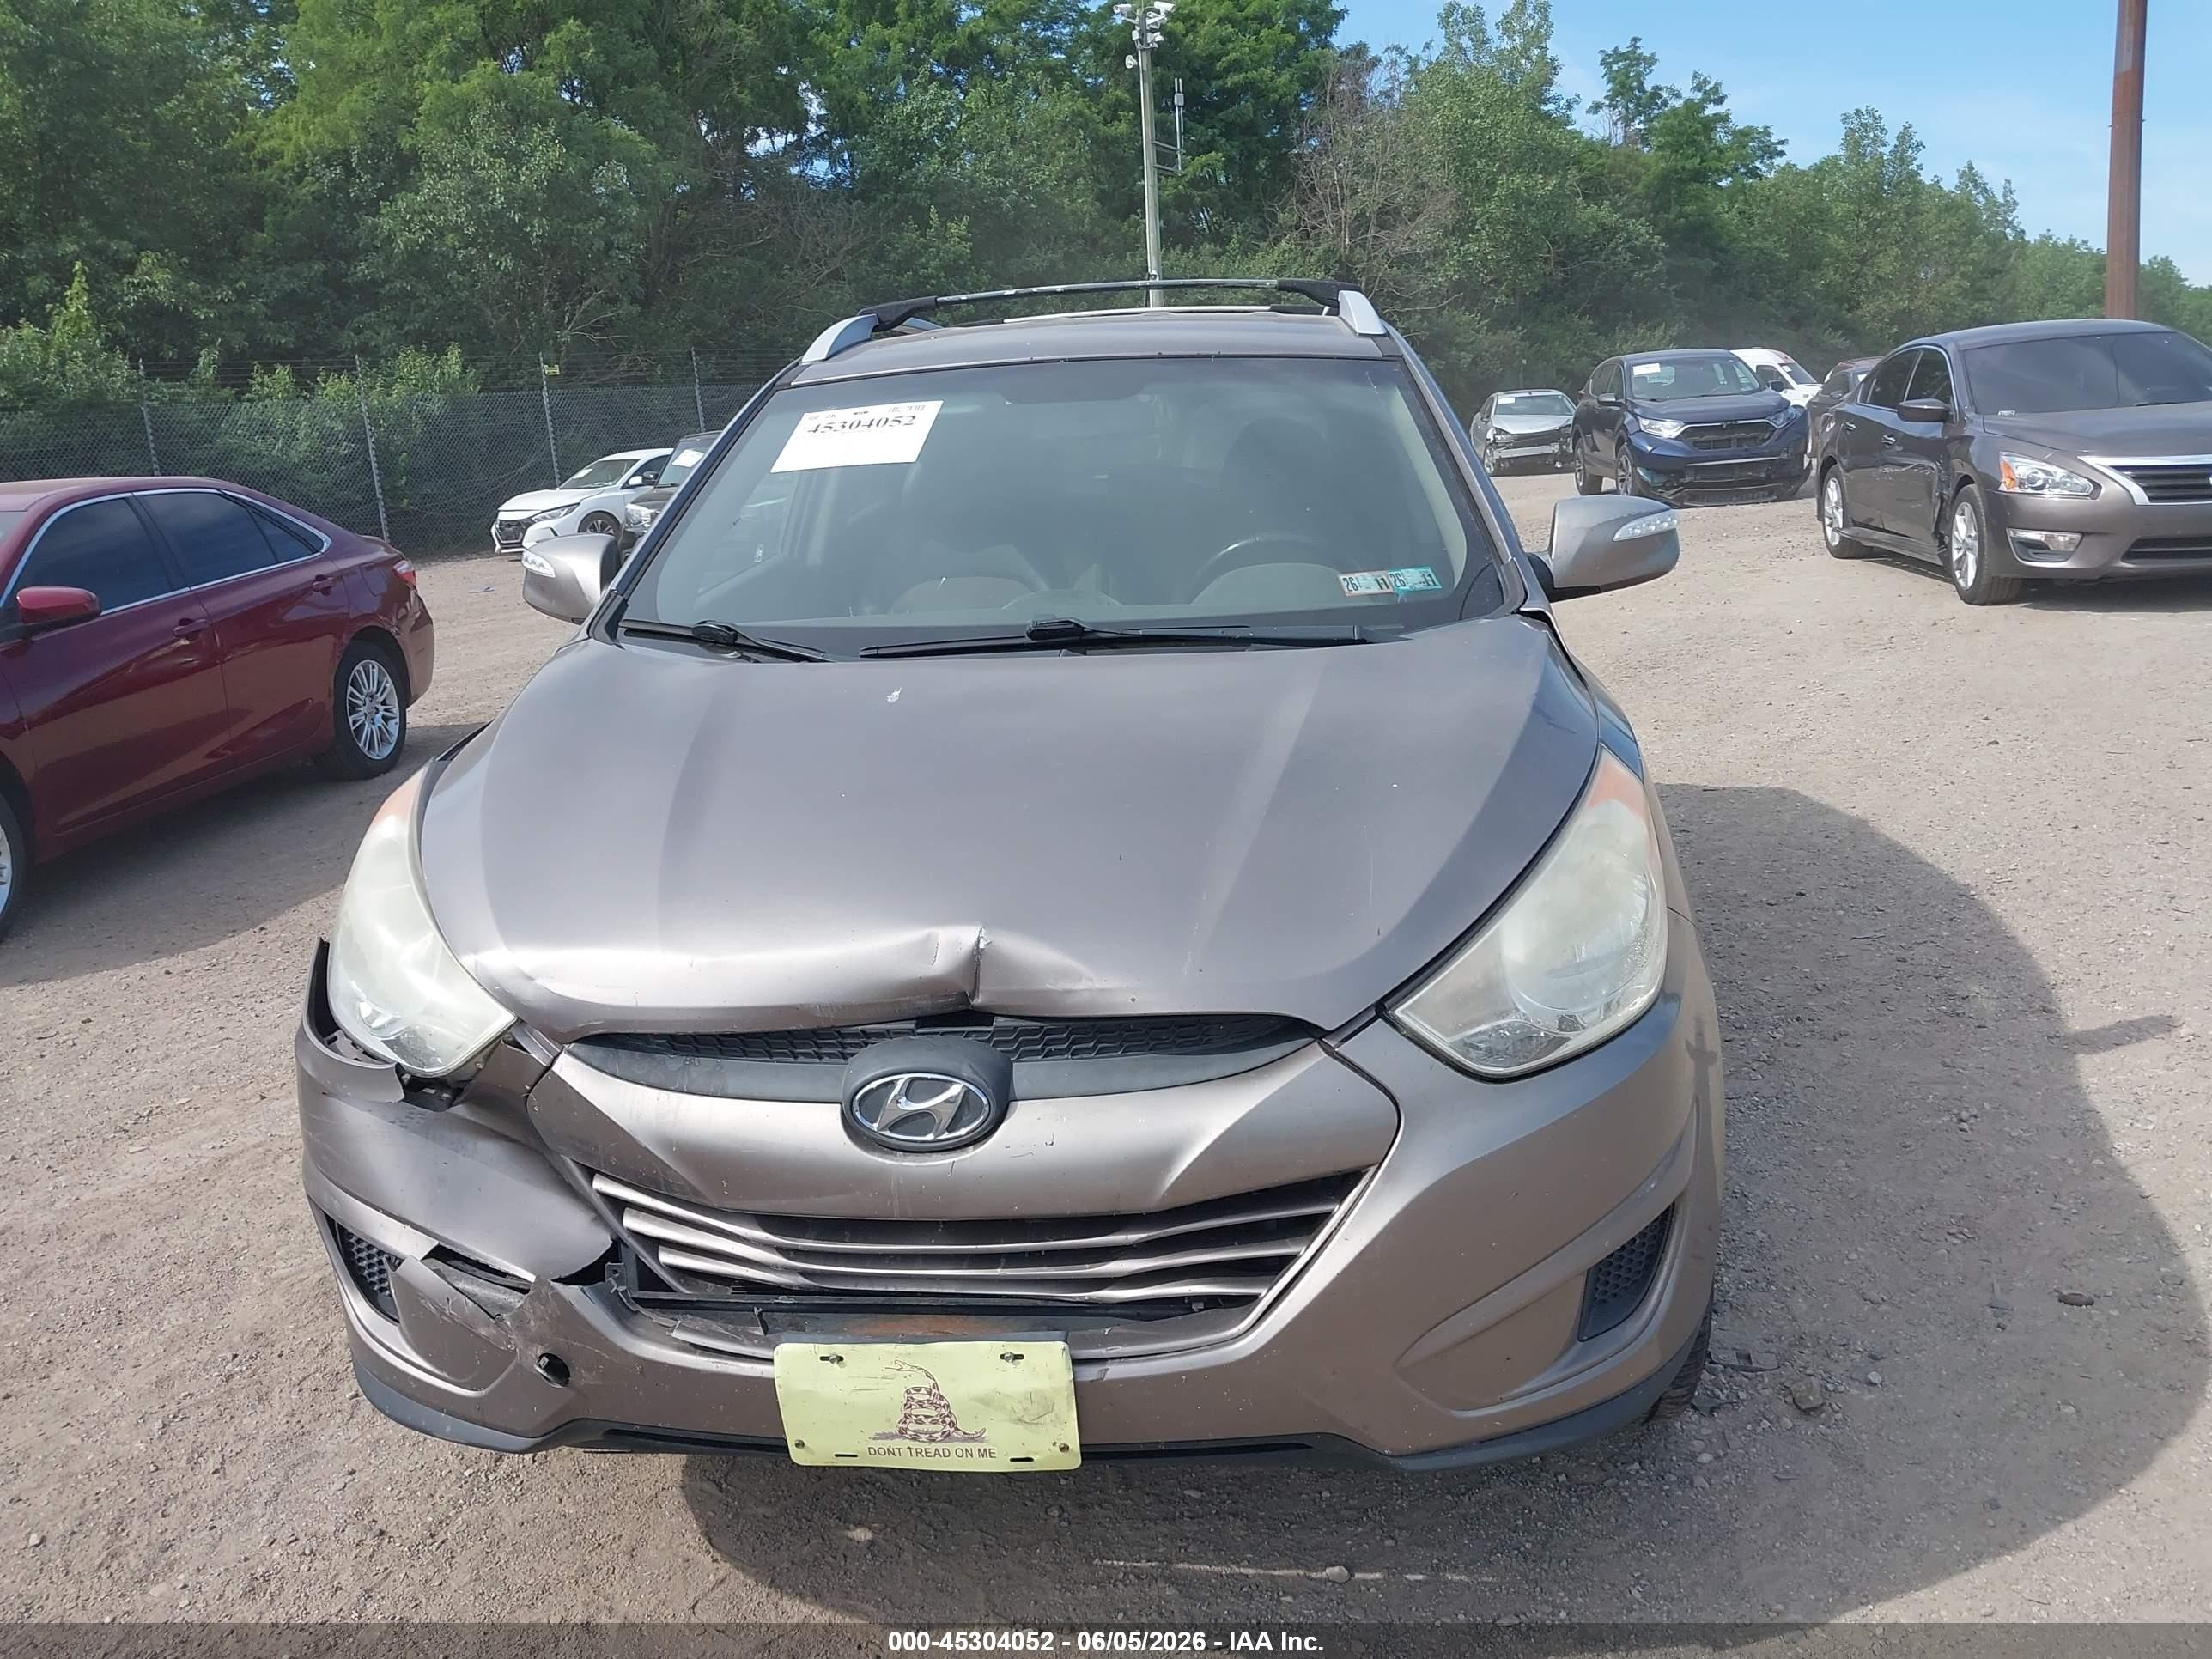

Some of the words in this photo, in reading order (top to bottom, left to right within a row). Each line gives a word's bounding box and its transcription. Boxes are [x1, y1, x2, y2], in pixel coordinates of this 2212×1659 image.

[807, 415, 916, 433] 45304052
[1342, 576, 1358, 592] 26
[1389, 573, 1406, 587] 26
[907, 1446, 951, 1458] TREAD
[955, 1448, 974, 1458] ON
[977, 1448, 997, 1459] ME
